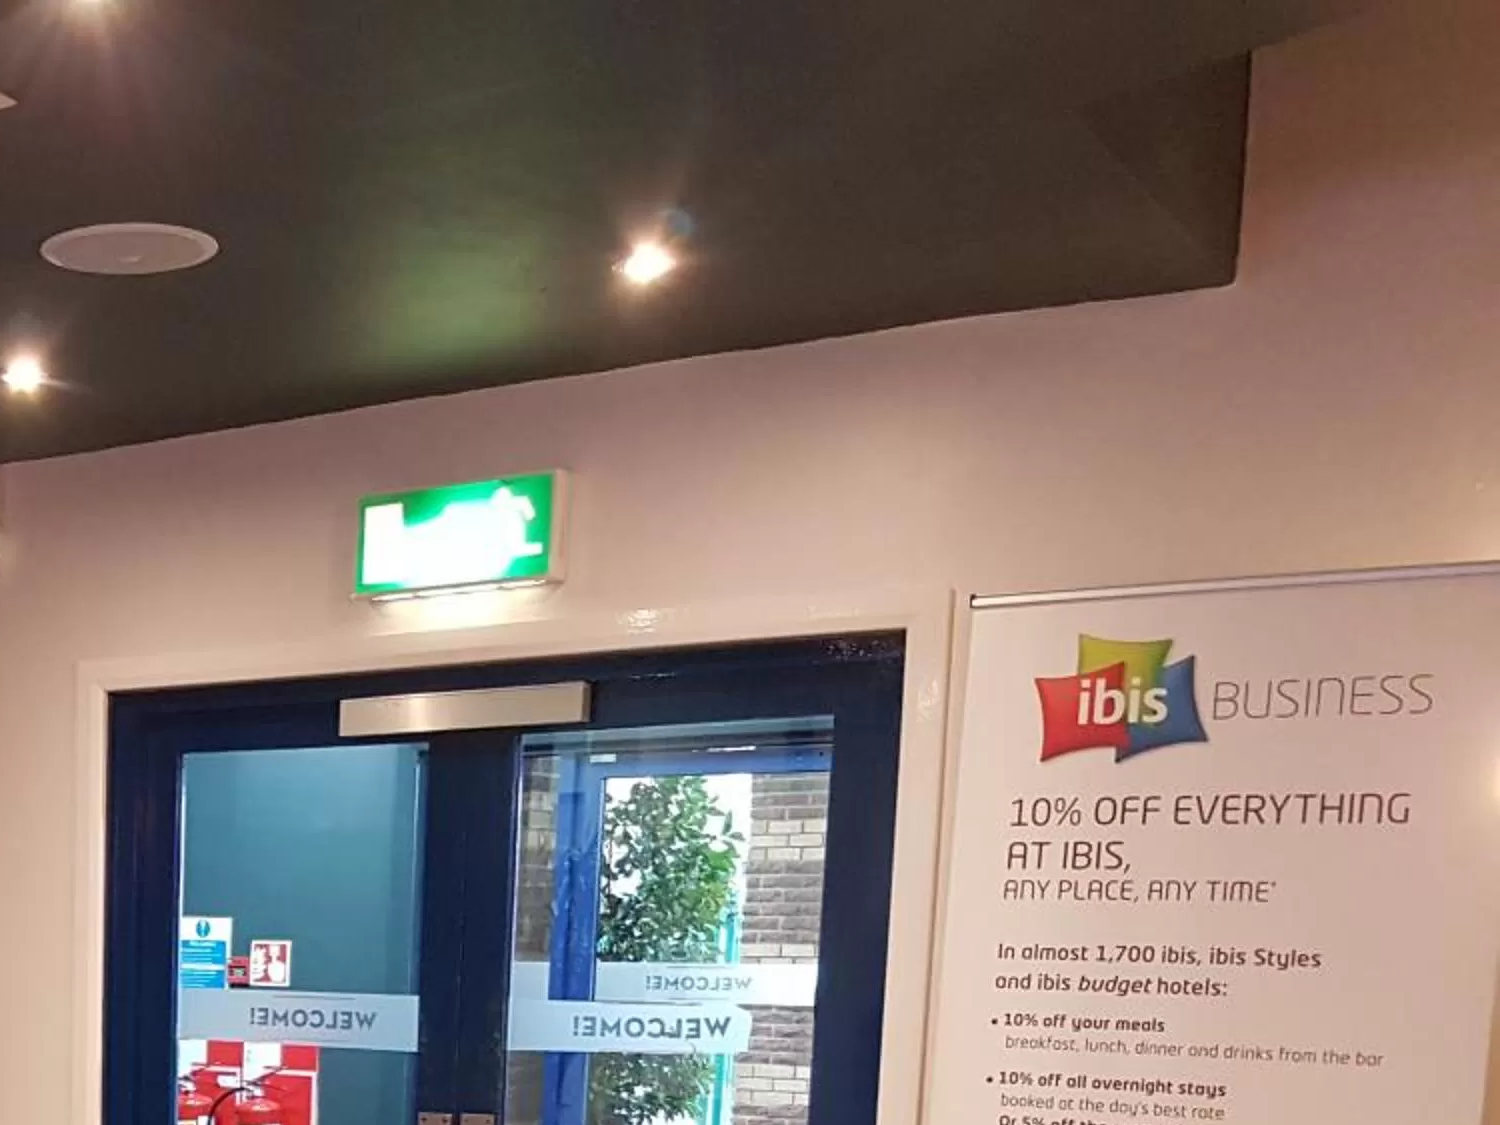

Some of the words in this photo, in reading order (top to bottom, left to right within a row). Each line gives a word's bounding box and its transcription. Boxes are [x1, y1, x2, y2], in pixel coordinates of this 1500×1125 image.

[1077, 677, 1168, 726] ibis
[1212, 674, 1434, 721] BUSINESS
[1009, 797, 1081, 827] 10%
[1094, 795, 1161, 826] OFF
[1173, 793, 1411, 825] EVERYTHING
[1007, 841, 1052, 870] AT
[1062, 841, 1131, 874] IBIS,
[1003, 880, 1051, 902] ANY
[1057, 880, 1139, 903] PLACE,
[1148, 880, 1198, 902] ANY
[998, 944, 1015, 960] In
[1021, 944, 1088, 961] almost
[1095, 945, 1156, 963] 1,700
[1161, 946, 1201, 966] ibis,
[1209, 947, 1247, 966] ibis
[1253, 948, 1322, 970] Styles
[995, 974, 1032, 990] and
[1037, 974, 1071, 990] ibis
[1078, 976, 1153, 996] budget
[1156, 977, 1228, 996] hotels:
[1003, 1013, 1038, 1027] 10%
[1043, 1014, 1067, 1028] off
[1072, 1017, 1110, 1032] your
[1115, 1018, 1165, 1032] meals
[1005, 1036, 1080, 1052] breakfast,
[1135, 1041, 1184, 1056] dinner
[1187, 1044, 1219, 1058] and
[1223, 1045, 1273, 1061] drinks
[1279, 1047, 1317, 1063] from
[1323, 1051, 1350, 1065] the
[1355, 1052, 1384, 1066] bar
[1000, 1072, 1033, 1086] 10%
[1038, 1074, 1062, 1087] off
[1066, 1076, 1087, 1089] all
[1092, 1078, 1173, 1096] overnight
[1179, 1082, 1227, 1099] stays
[1001, 1093, 1054, 1109] booked
[1058, 1098, 1074, 1110] at
[1079, 1099, 1105, 1113] the
[1153, 1104, 1187, 1118] best
[1192, 1106, 1225, 1120] rate
